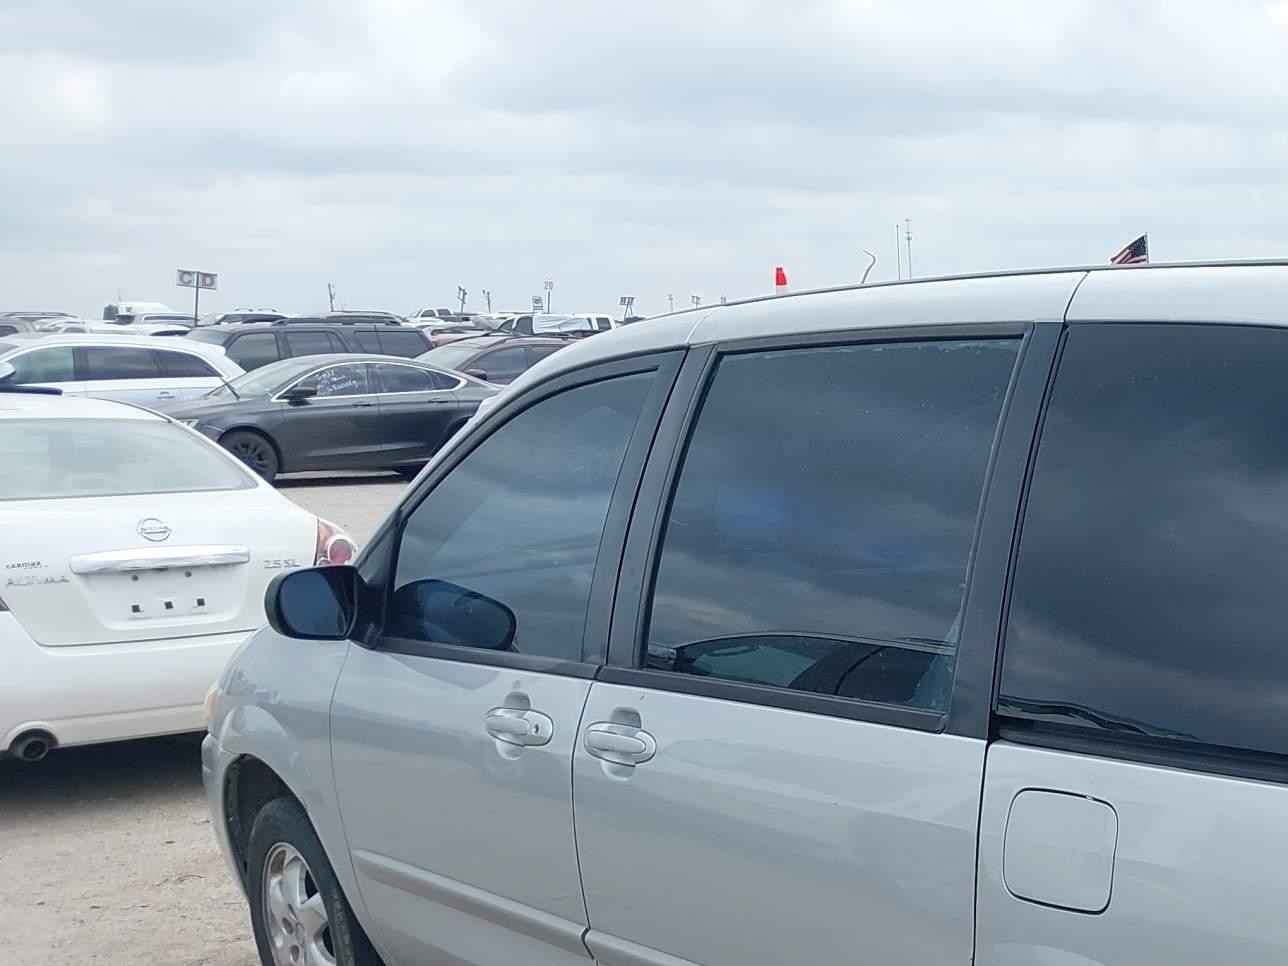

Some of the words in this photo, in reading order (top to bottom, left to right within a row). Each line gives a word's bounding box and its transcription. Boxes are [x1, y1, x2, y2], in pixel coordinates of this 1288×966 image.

[179, 271, 193, 285] C
[201, 273, 215, 287] D
[544, 280, 554, 291] 20
